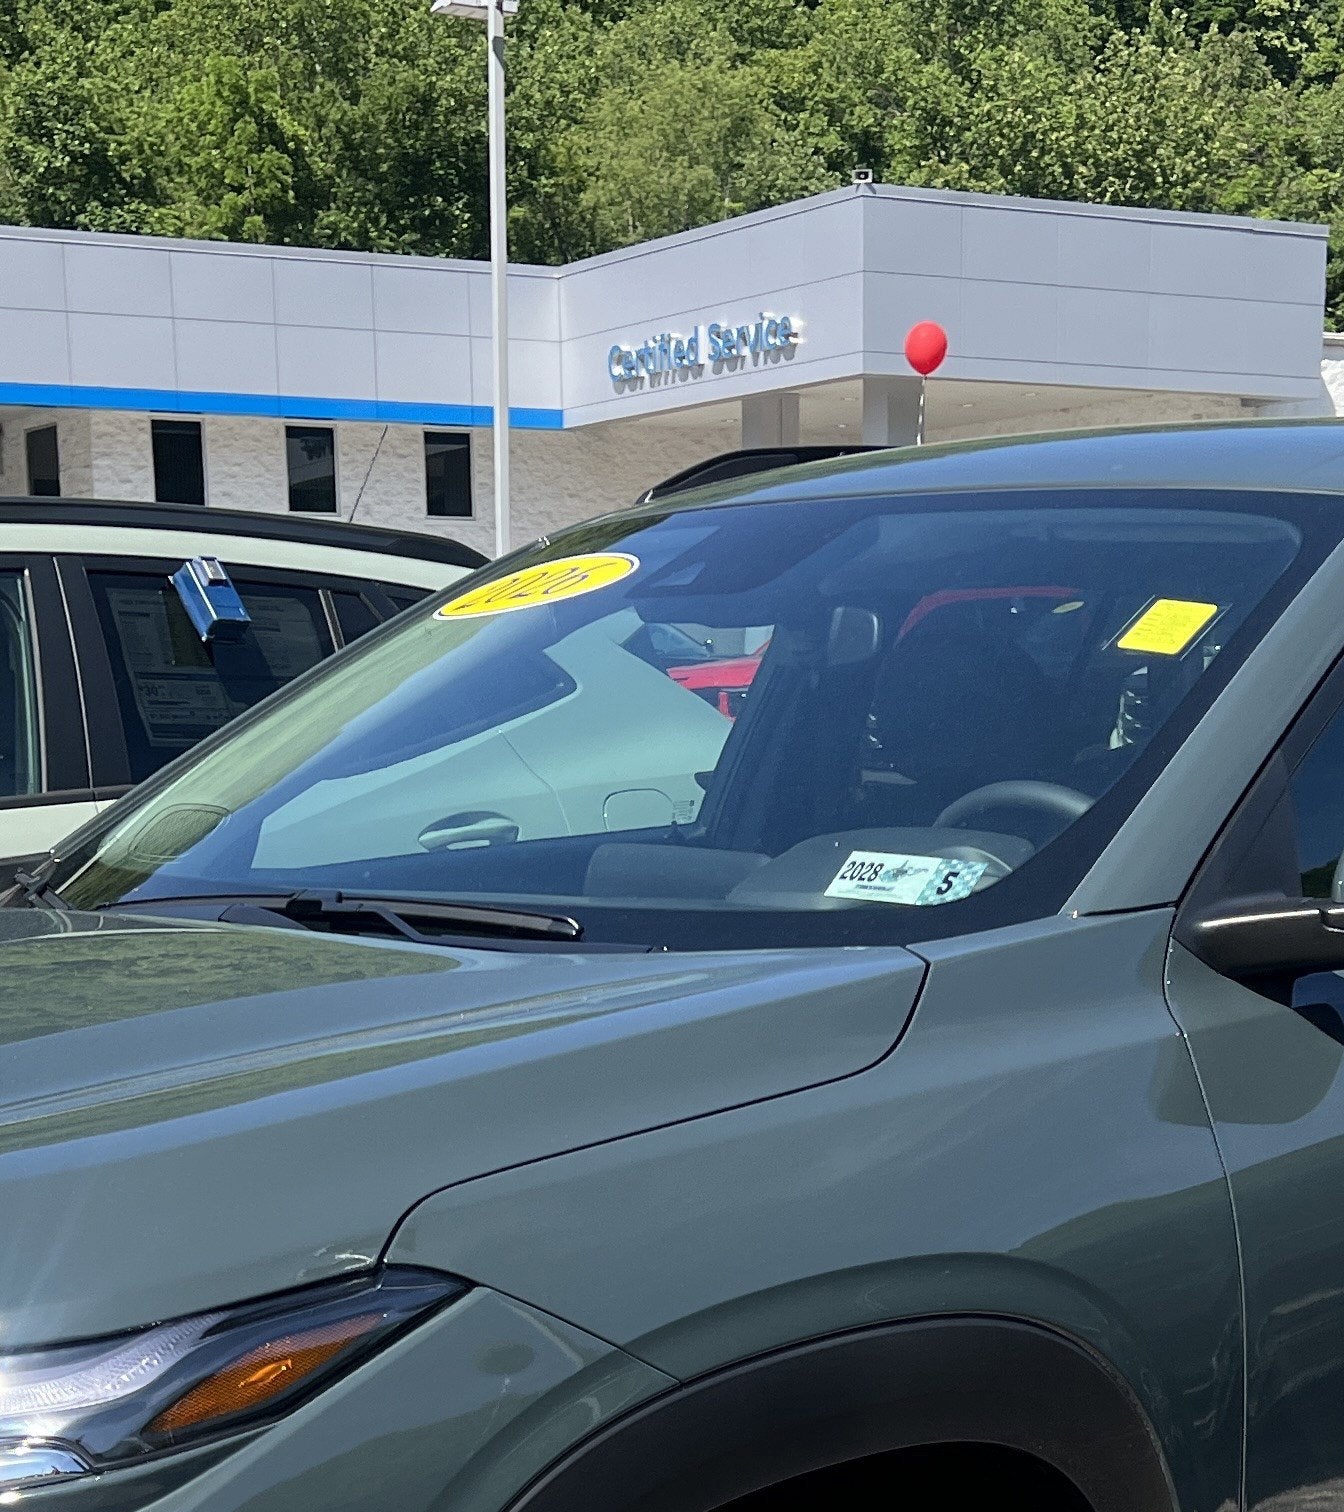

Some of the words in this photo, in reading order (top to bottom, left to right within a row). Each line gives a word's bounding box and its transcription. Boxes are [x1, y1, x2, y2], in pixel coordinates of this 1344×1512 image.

[608, 325, 701, 382] Certified
[708, 312, 799, 362] Service
[450, 561, 619, 613] 2026
[838, 860, 885, 883] 2028
[935, 871, 960, 896] 5
